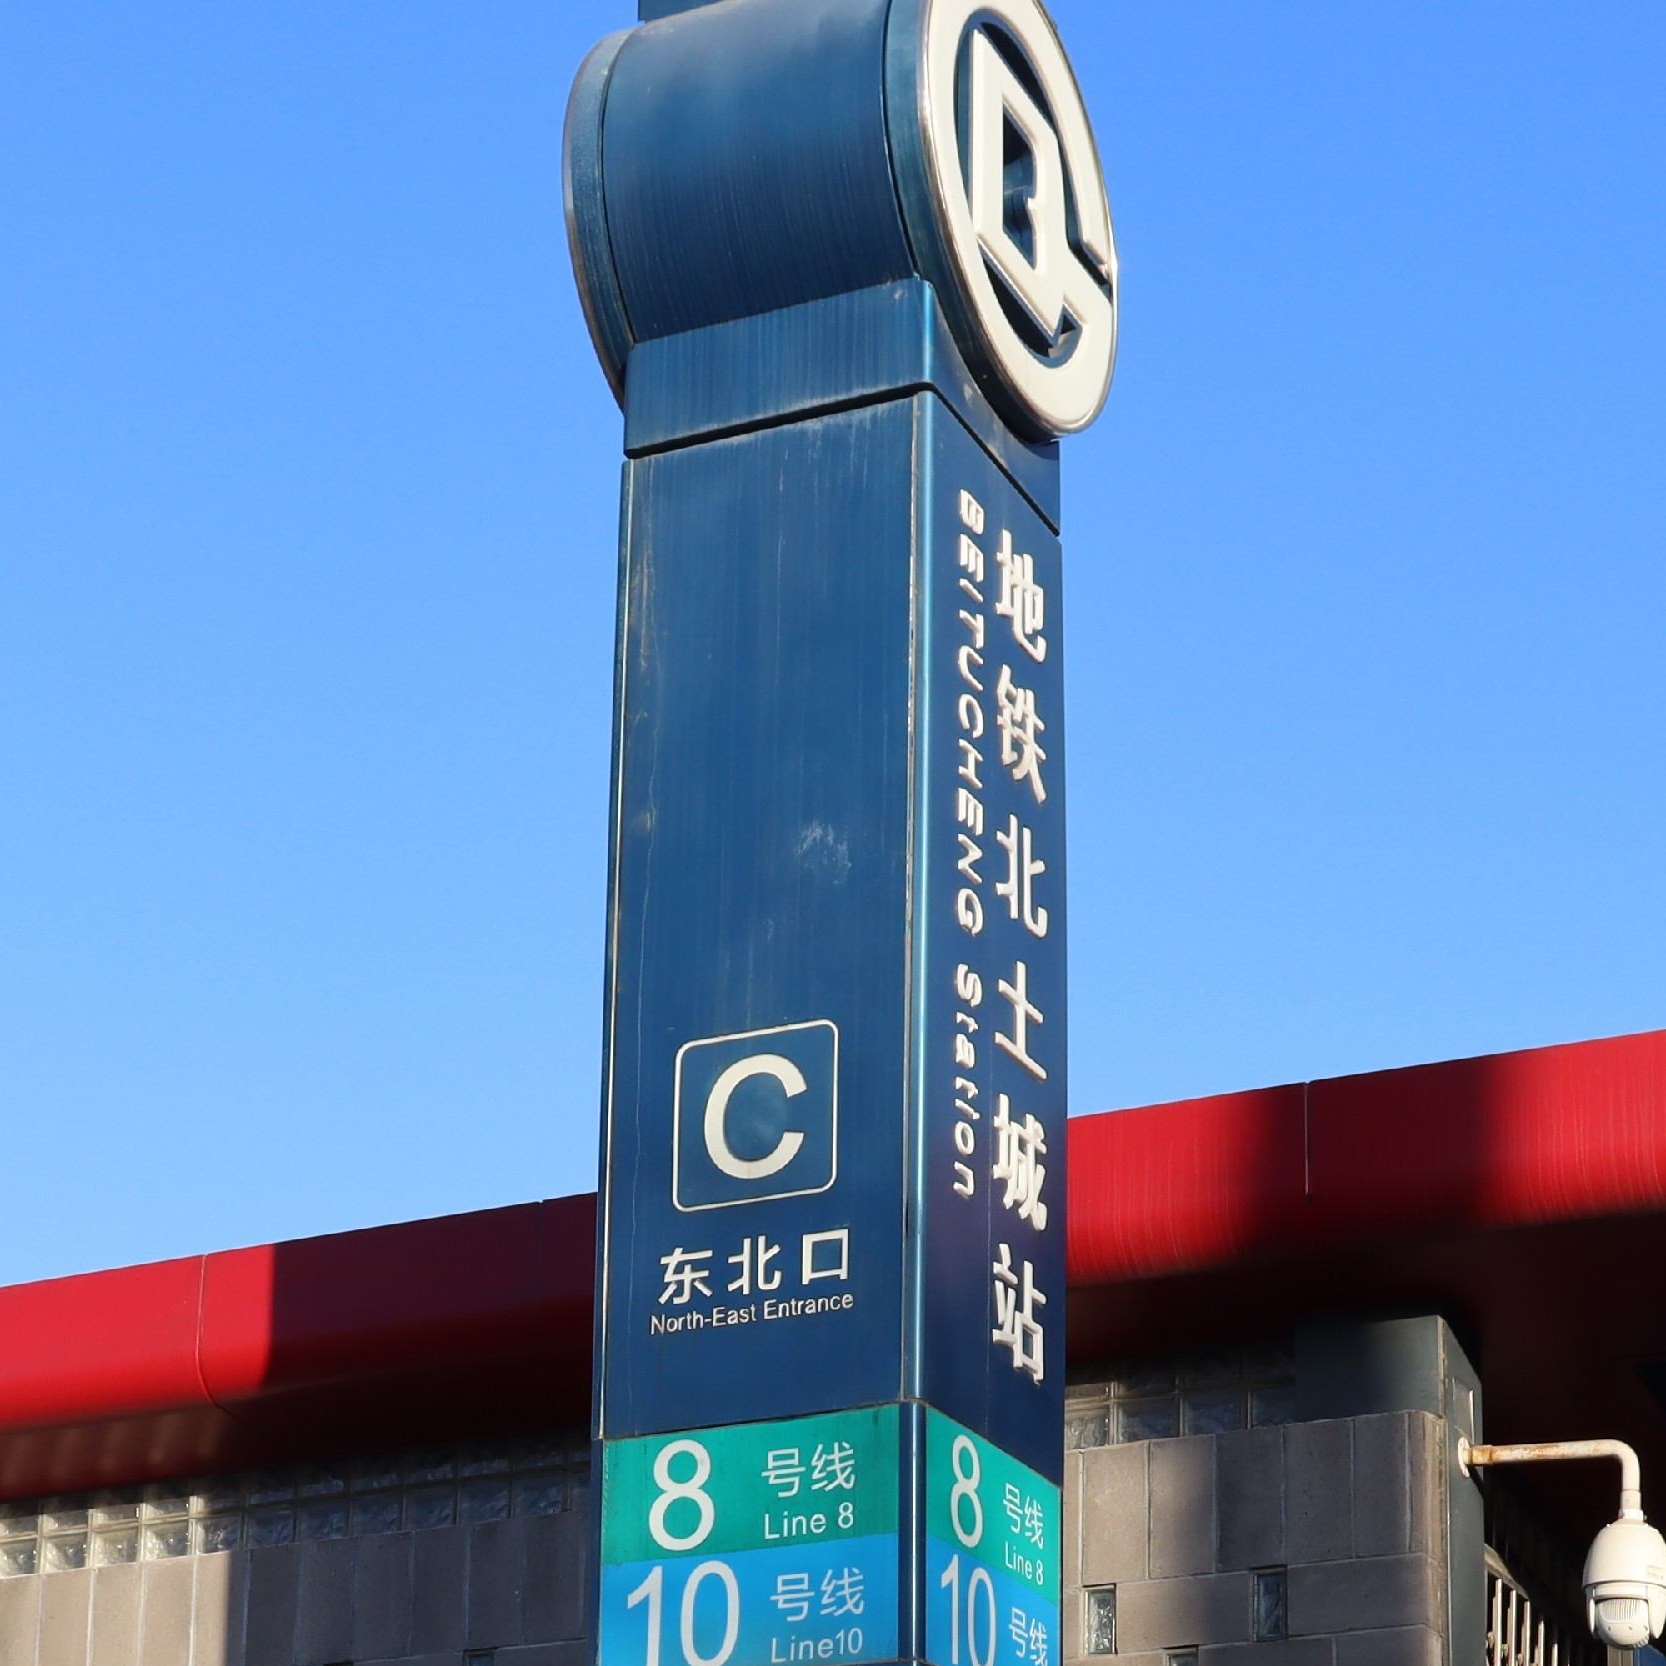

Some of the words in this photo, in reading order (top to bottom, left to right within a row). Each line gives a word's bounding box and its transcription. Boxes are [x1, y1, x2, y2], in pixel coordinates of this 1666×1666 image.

[992, 528, 1049, 1384] 地铁北土城站
[703, 1053, 808, 1180] C
[953, 963, 982, 1199] Station
[650, 1302, 757, 1335] North-East
[763, 1290, 854, 1321] Entrance
[658, 1228, 850, 1306] 东北口
[648, 1438, 715, 1552] 8
[760, 1442, 856, 1498] 号线
[764, 1509, 827, 1540] Line
[837, 1502, 855, 1528] 8
[950, 1435, 983, 1549] 8
[1003, 1483, 1045, 1549] 号线
[770, 1568, 865, 1624] 号线
[1005, 1541, 1034, 1580] Line
